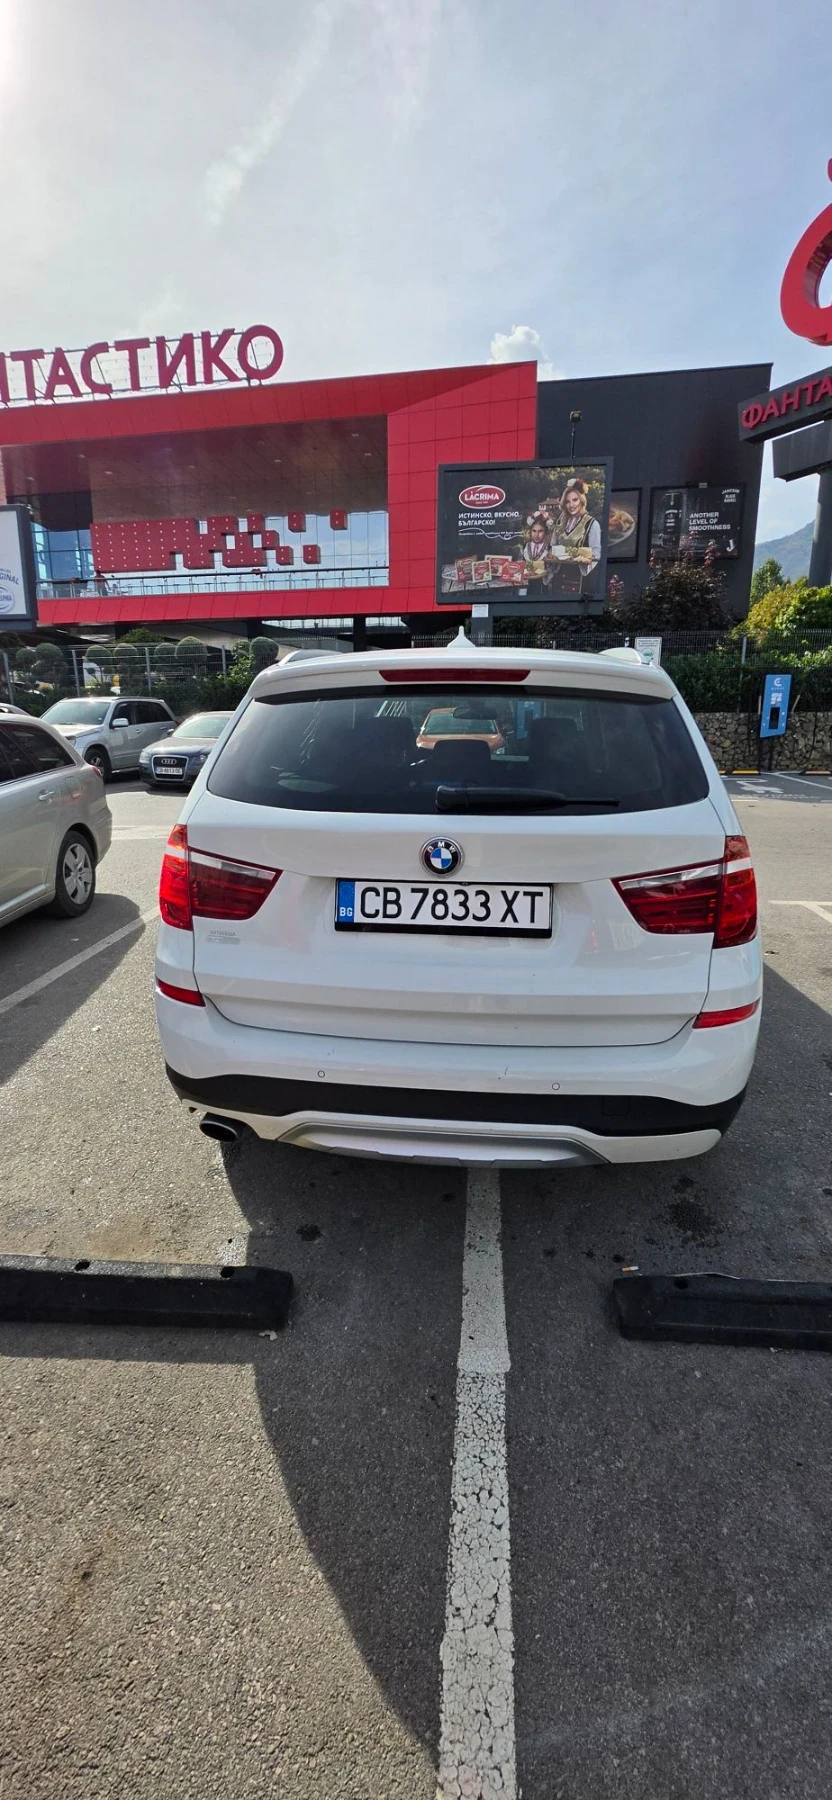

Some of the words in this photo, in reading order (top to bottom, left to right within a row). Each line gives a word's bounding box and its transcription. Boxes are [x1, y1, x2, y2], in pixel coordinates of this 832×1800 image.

[458, 519, 496, 527] БЪЛГАРСКО!
[427, 841, 457, 853] BMW
[339, 907, 353, 917] BG
[360, 886, 402, 919] CB
[410, 887, 491, 922] 7833
[500, 890, 544, 924] XT
